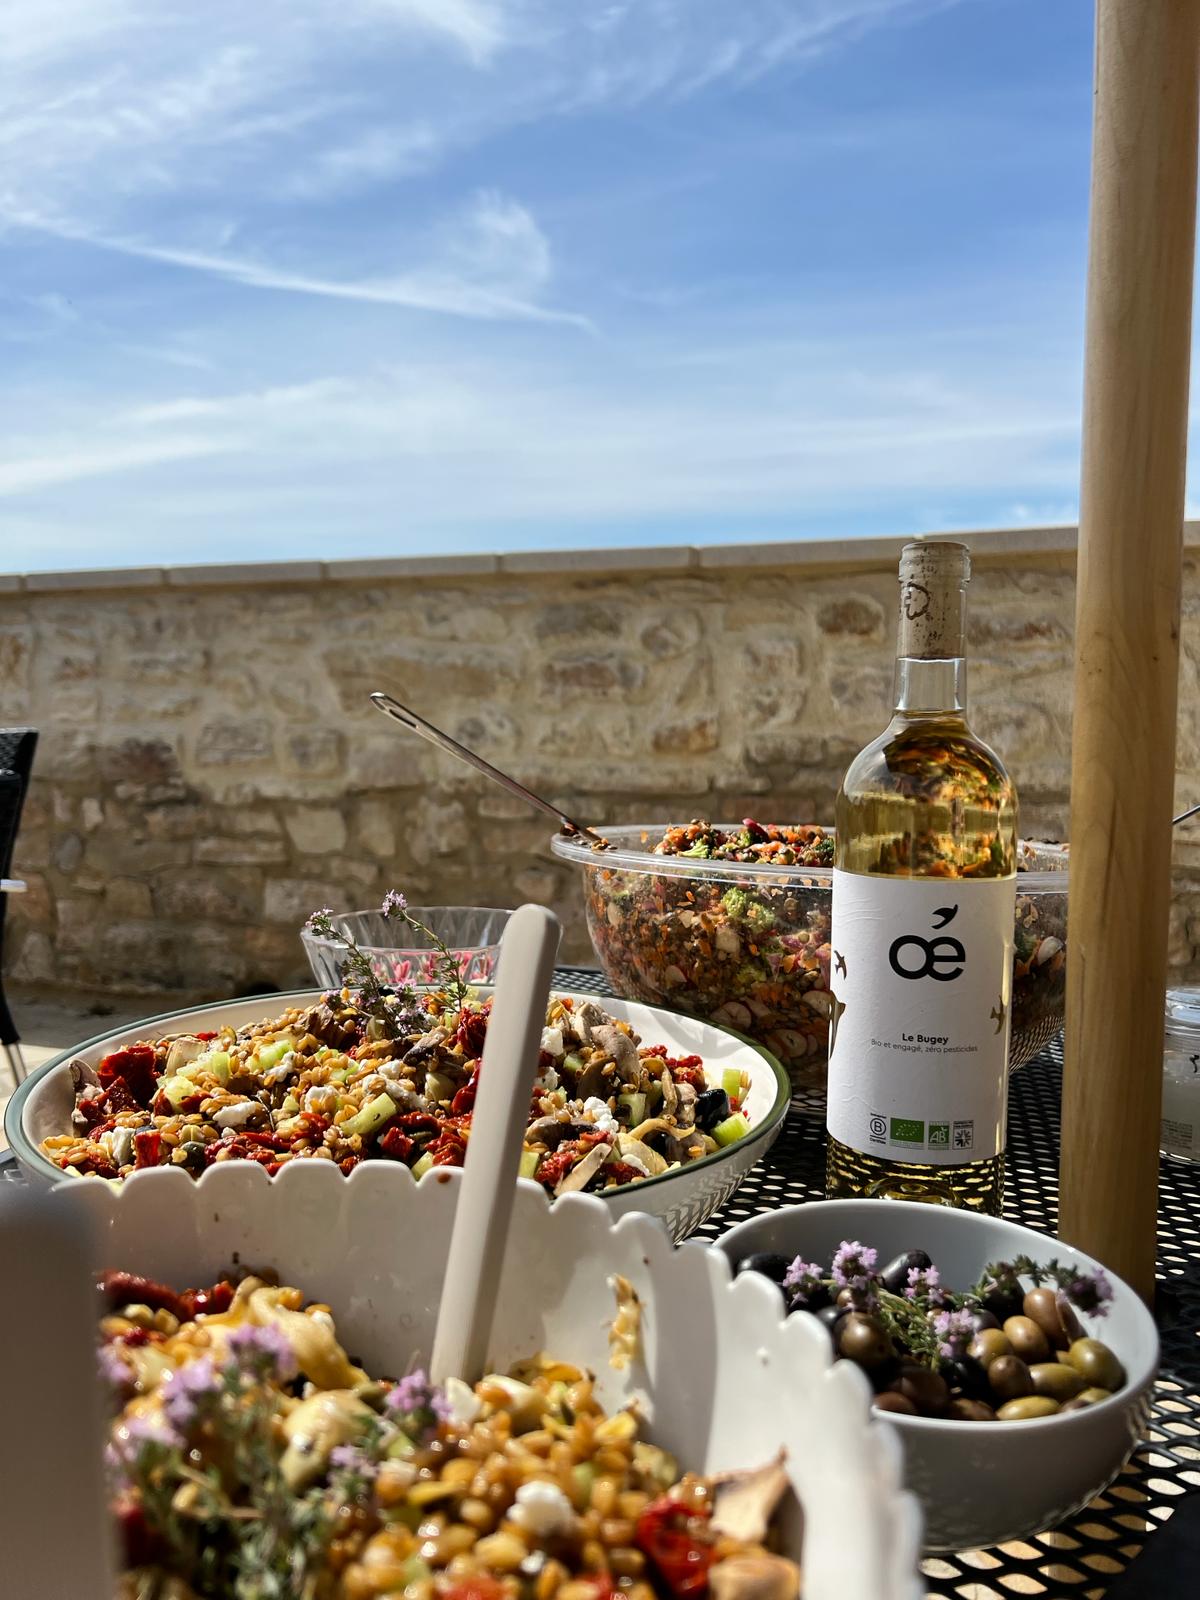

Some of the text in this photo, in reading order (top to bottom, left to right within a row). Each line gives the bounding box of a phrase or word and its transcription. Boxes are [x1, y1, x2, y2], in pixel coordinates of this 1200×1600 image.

[902, 1033, 949, 1046] Le Bugey
[871, 1038, 882, 1047] Bio
[925, 1045, 942, 1054] zéro
[943, 1045, 978, 1054] pesticides
[874, 1121, 882, 1132] B
[929, 1131, 946, 1143] AB
